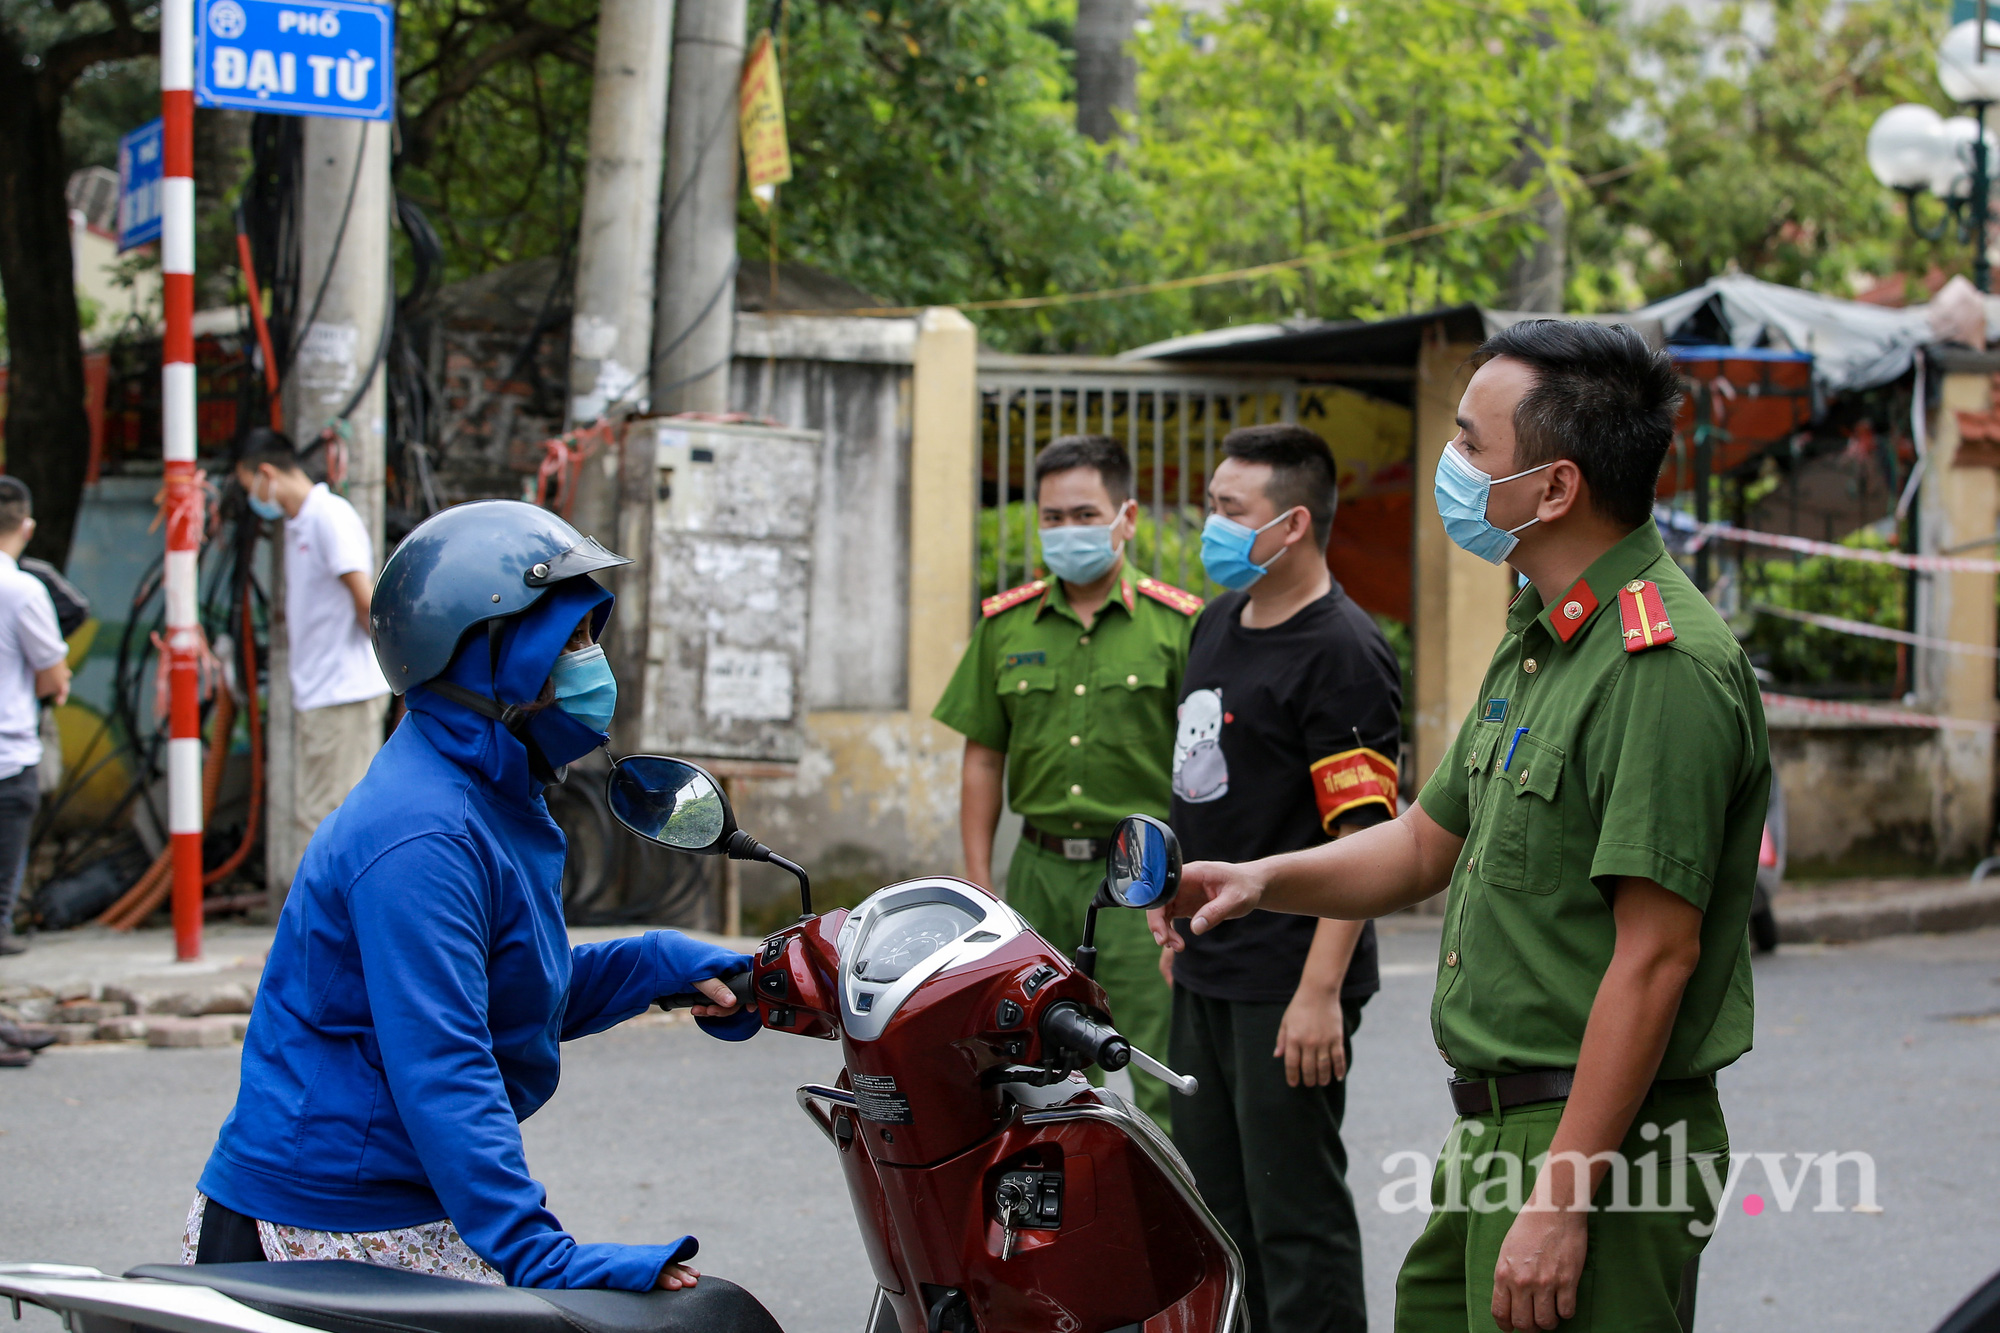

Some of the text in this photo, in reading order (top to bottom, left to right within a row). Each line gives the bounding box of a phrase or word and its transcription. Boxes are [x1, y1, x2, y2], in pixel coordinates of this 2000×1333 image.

[278, 8, 341, 38] PHỐ
[212, 46, 375, 101] ĐẠI TỪ
